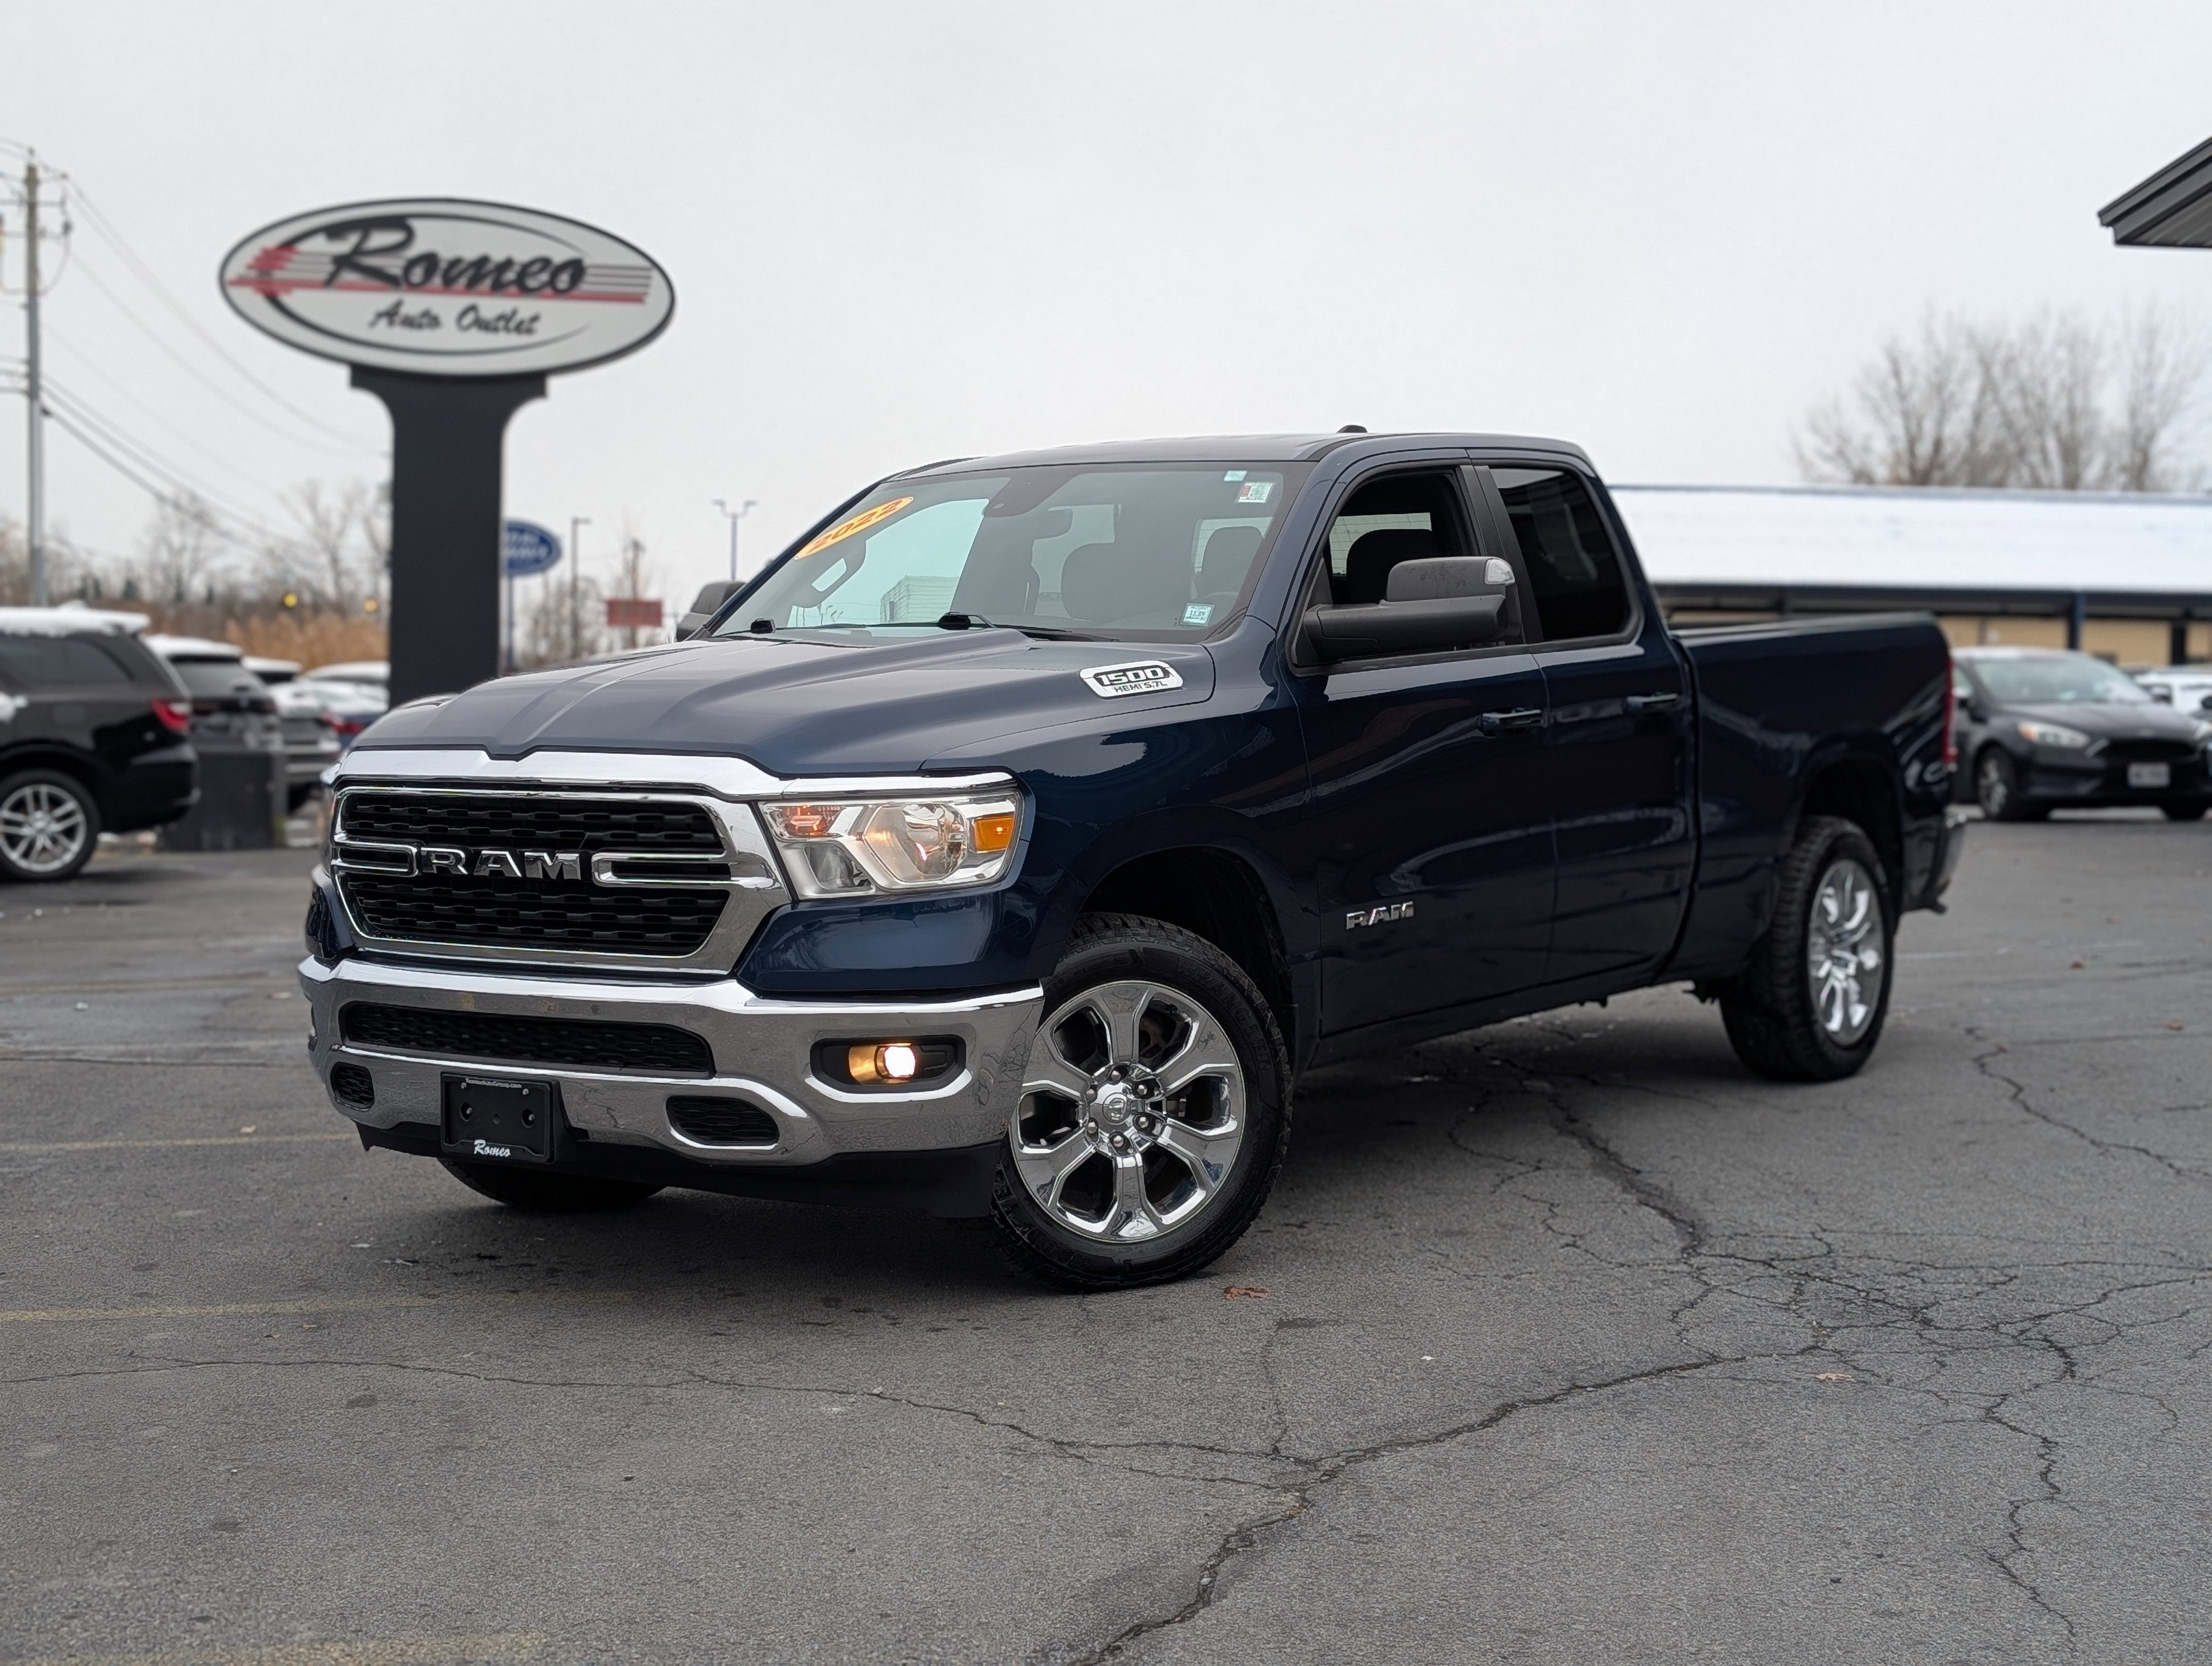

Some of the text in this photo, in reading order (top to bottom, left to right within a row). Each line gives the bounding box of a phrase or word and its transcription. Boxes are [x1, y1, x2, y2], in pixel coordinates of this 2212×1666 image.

[323, 216, 586, 294] Romeo
[369, 298, 541, 335] Auto Outlet
[805, 499, 904, 555] 2022
[1096, 667, 1165, 685] 1500
[1115, 683, 1143, 693] HEMI
[420, 847, 582, 881] RAM
[1346, 901, 1414, 930] RAM
[473, 1139, 511, 1157] Romeo
